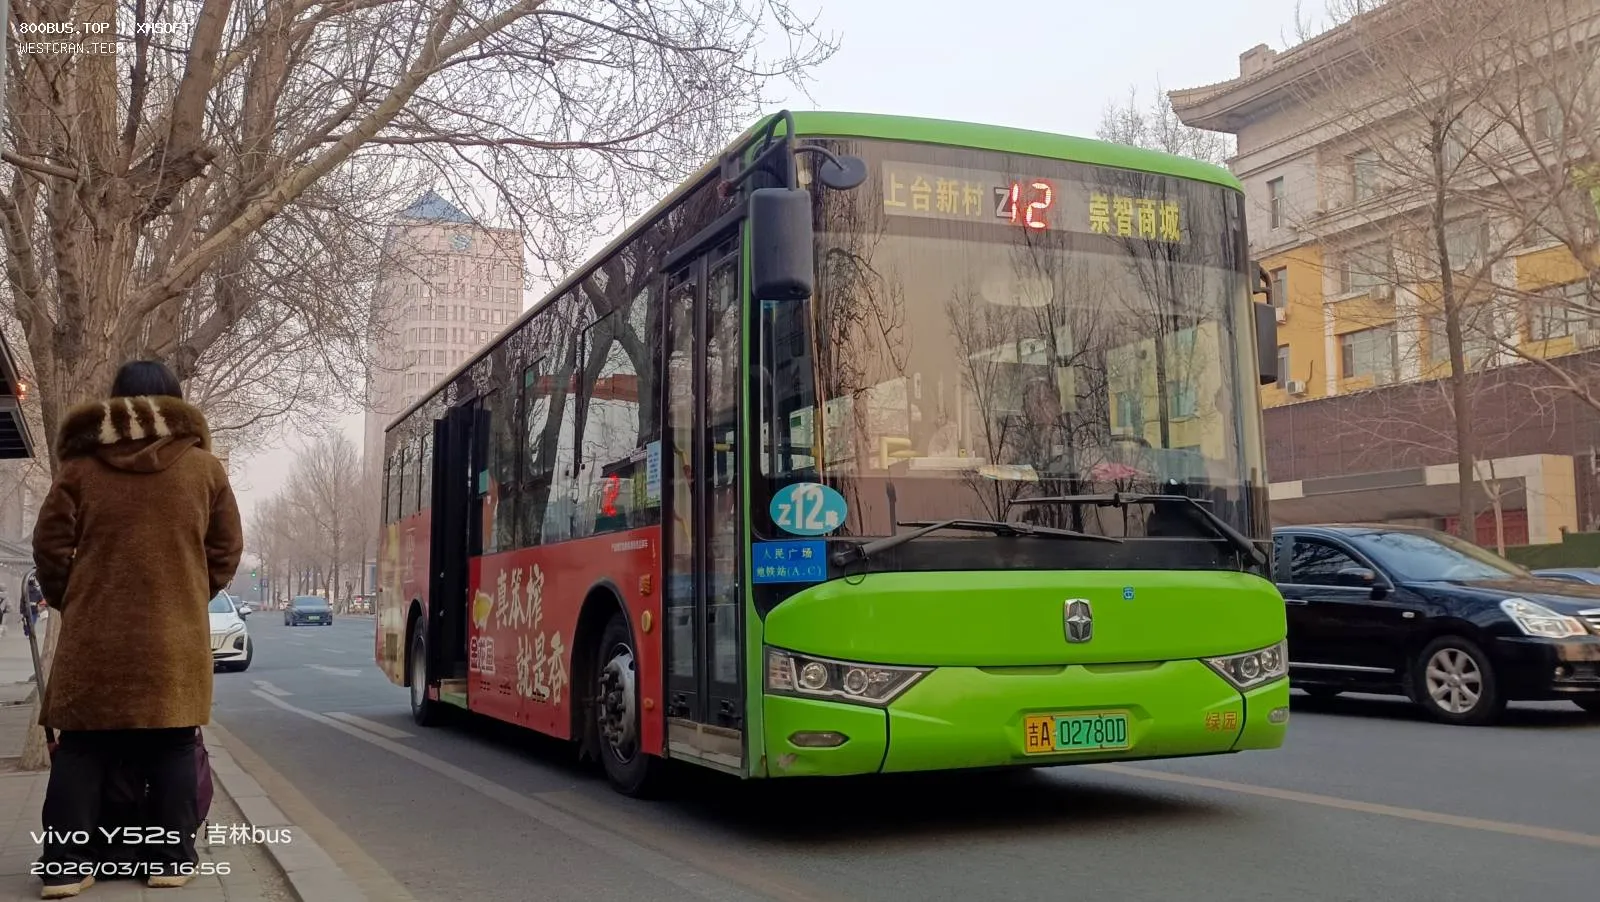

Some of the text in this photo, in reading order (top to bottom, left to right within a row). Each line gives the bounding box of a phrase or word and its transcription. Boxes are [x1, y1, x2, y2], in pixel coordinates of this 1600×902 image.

[884, 171, 1180, 242] 上台新村 Z12 崇智商城
[763, 547, 813, 560] 人民广场
[516, 630, 568, 706] 就是香
[1028, 717, 1127, 748] 吉A 02780D
[1205, 711, 1238, 733] 绿园
